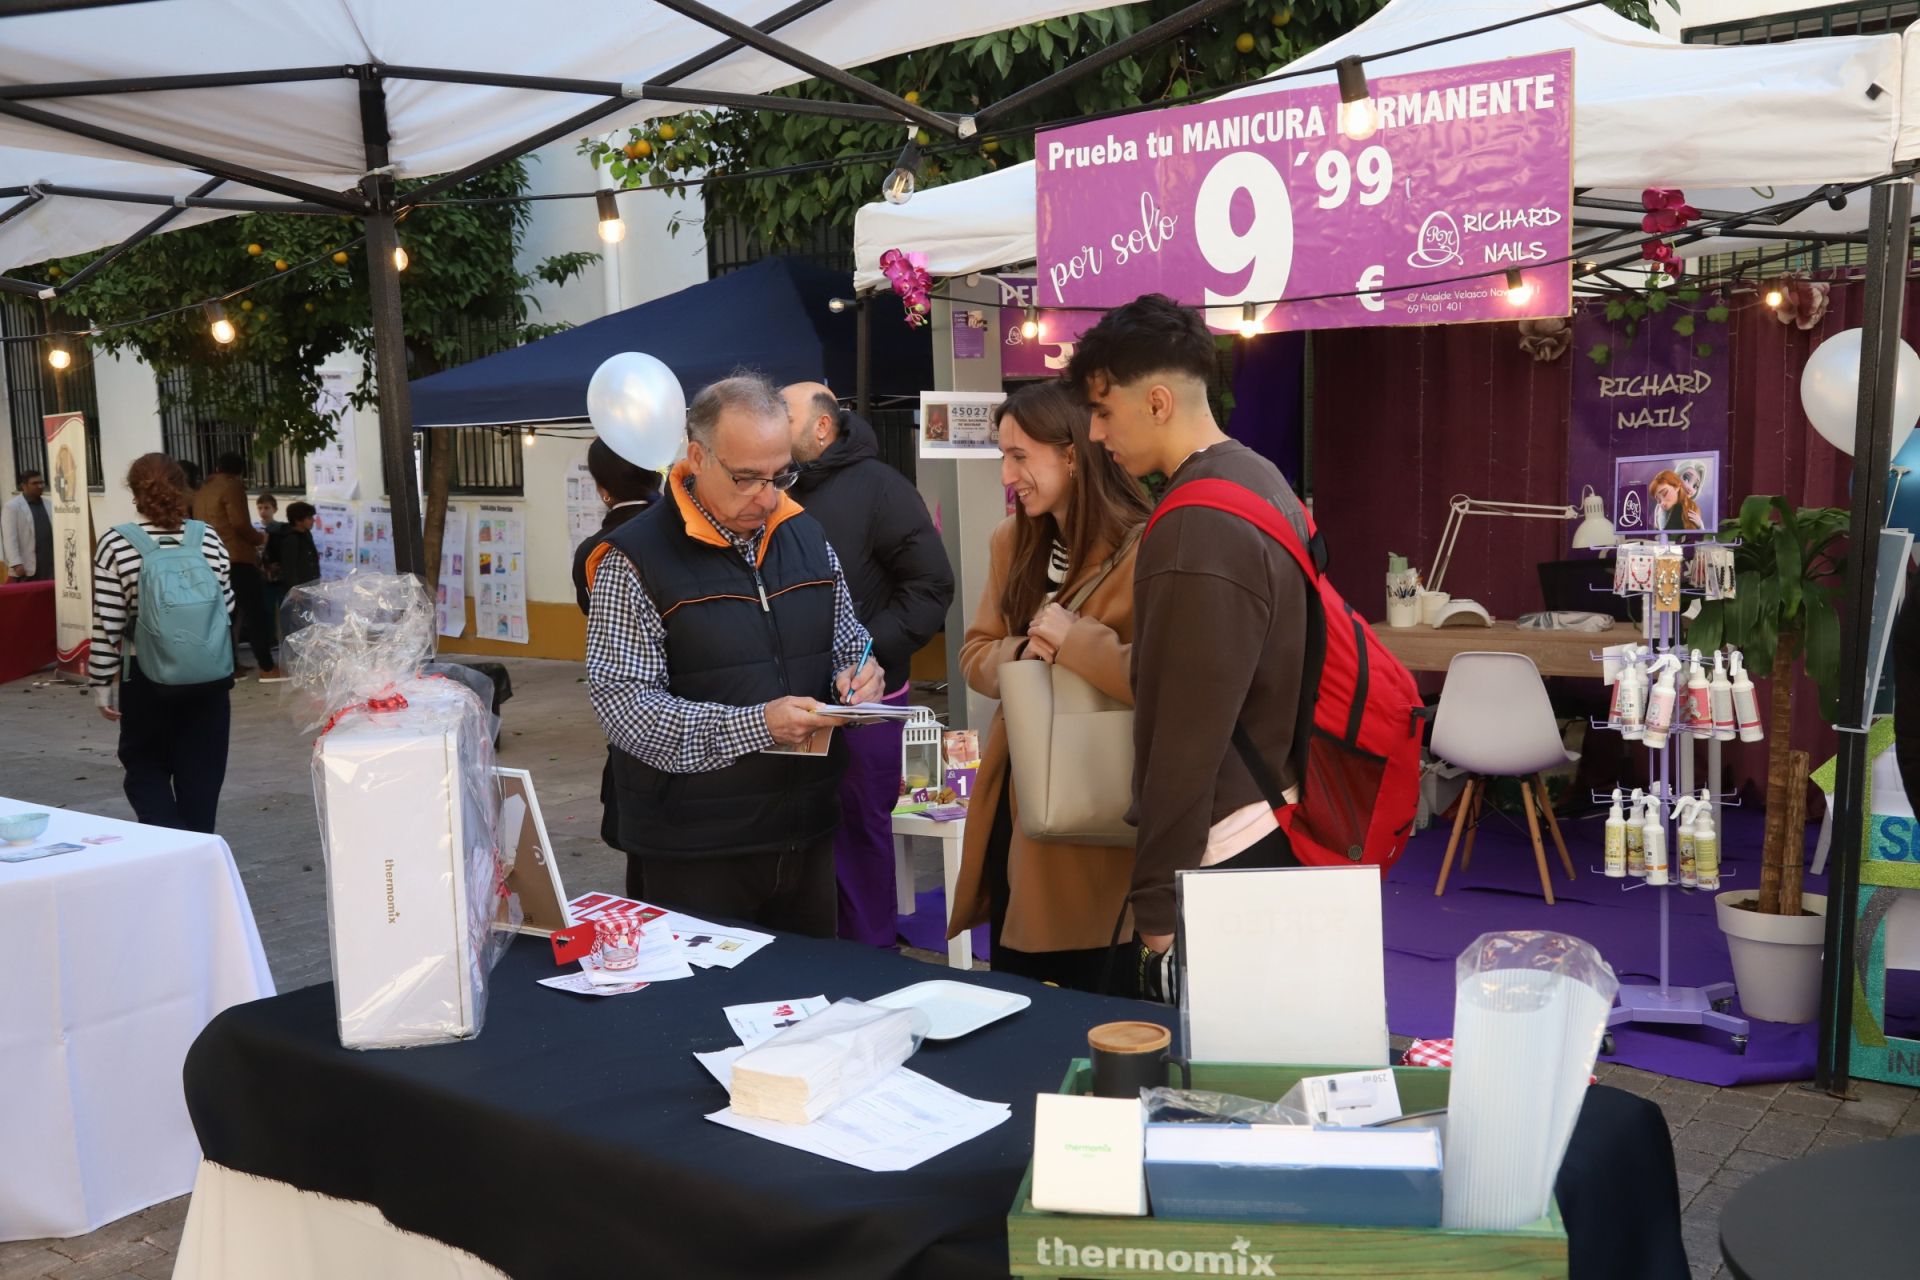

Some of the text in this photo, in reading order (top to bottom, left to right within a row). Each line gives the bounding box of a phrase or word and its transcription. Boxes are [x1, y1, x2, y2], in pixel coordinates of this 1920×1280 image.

[1048, 74, 1555, 171] Prueba tu MANICURA RMANENTE
[1463, 207, 1562, 233] RICHARD
[1485, 241, 1548, 264] NAILS
[1050, 245, 1102, 304] por
[1356, 265, 1385, 312] €
[1407, 302, 1462, 314] 691 101 401
[1421, 291, 1453, 301] Alcalde
[1454, 290, 1488, 300] Velasco
[1598, 369, 1712, 398] RICHARD
[951, 407, 988, 416] 45027
[1617, 401, 1695, 431] NAILS
[957, 775, 967, 796] 1
[385, 859, 401, 924] thermomix
[1887, 1049, 1920, 1077] IN
[1036, 1235, 1276, 1277] thermomix
